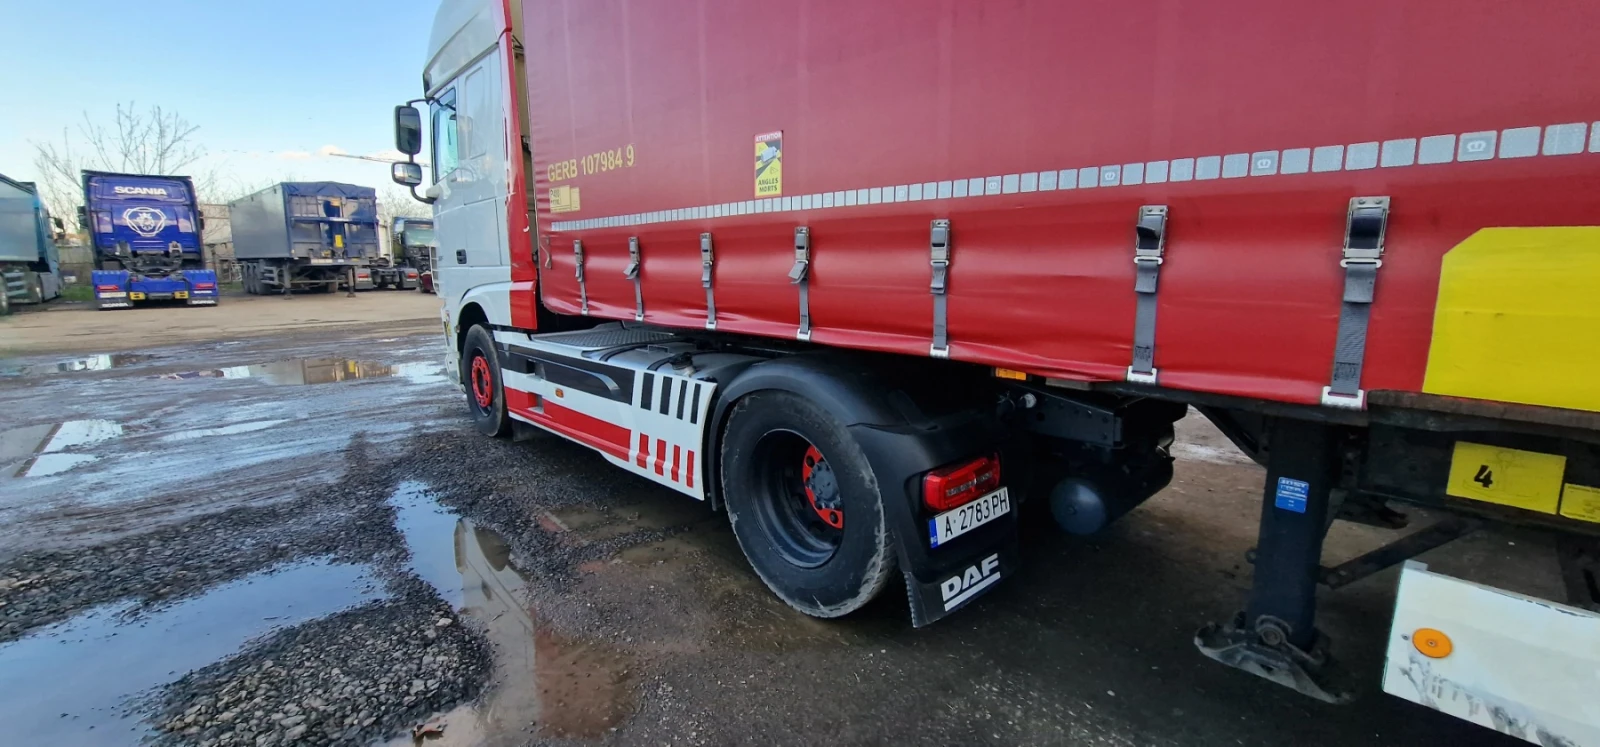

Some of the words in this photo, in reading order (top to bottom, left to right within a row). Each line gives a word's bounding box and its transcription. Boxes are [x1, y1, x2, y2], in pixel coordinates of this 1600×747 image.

[547, 159, 578, 182] GERB
[581, 147, 623, 175] 107984
[626, 144, 635, 167] 9
[114, 186, 167, 196] SCANIA
[758, 178, 779, 186] ANGLES
[759, 185, 778, 193] MORTS
[1473, 464, 1494, 488] 4
[945, 515, 953, 538] A
[958, 500, 991, 531] 2783
[991, 490, 1009, 516] PH
[940, 552, 999, 602] DAF
